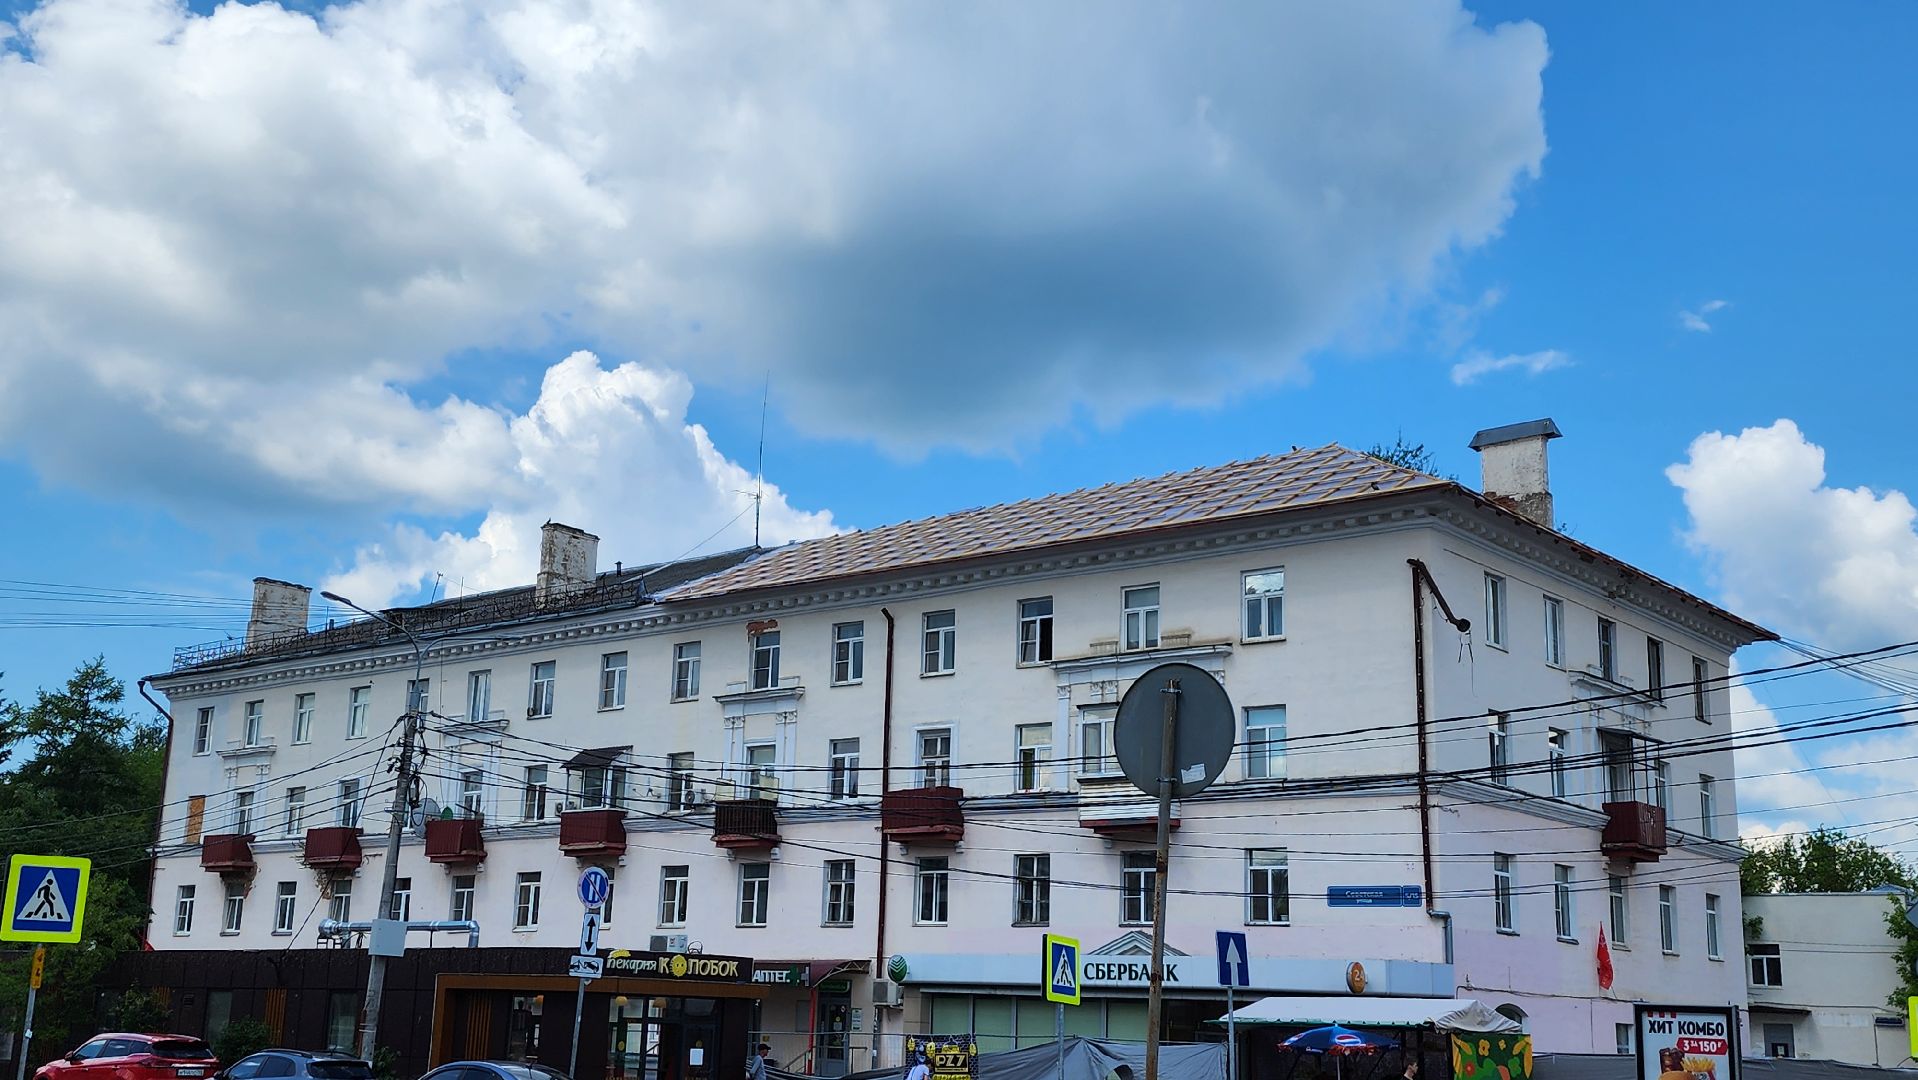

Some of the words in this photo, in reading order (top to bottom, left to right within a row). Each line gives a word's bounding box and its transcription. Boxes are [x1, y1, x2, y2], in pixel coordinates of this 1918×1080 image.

[658, 954, 739, 977] КОЛОБОК
[1084, 962, 1179, 982] СБЕРБАК
[1648, 1019, 1674, 1034] ХИТ
[1678, 1020, 1725, 1037] КОМБО
[1698, 1040, 1717, 1053] 150
